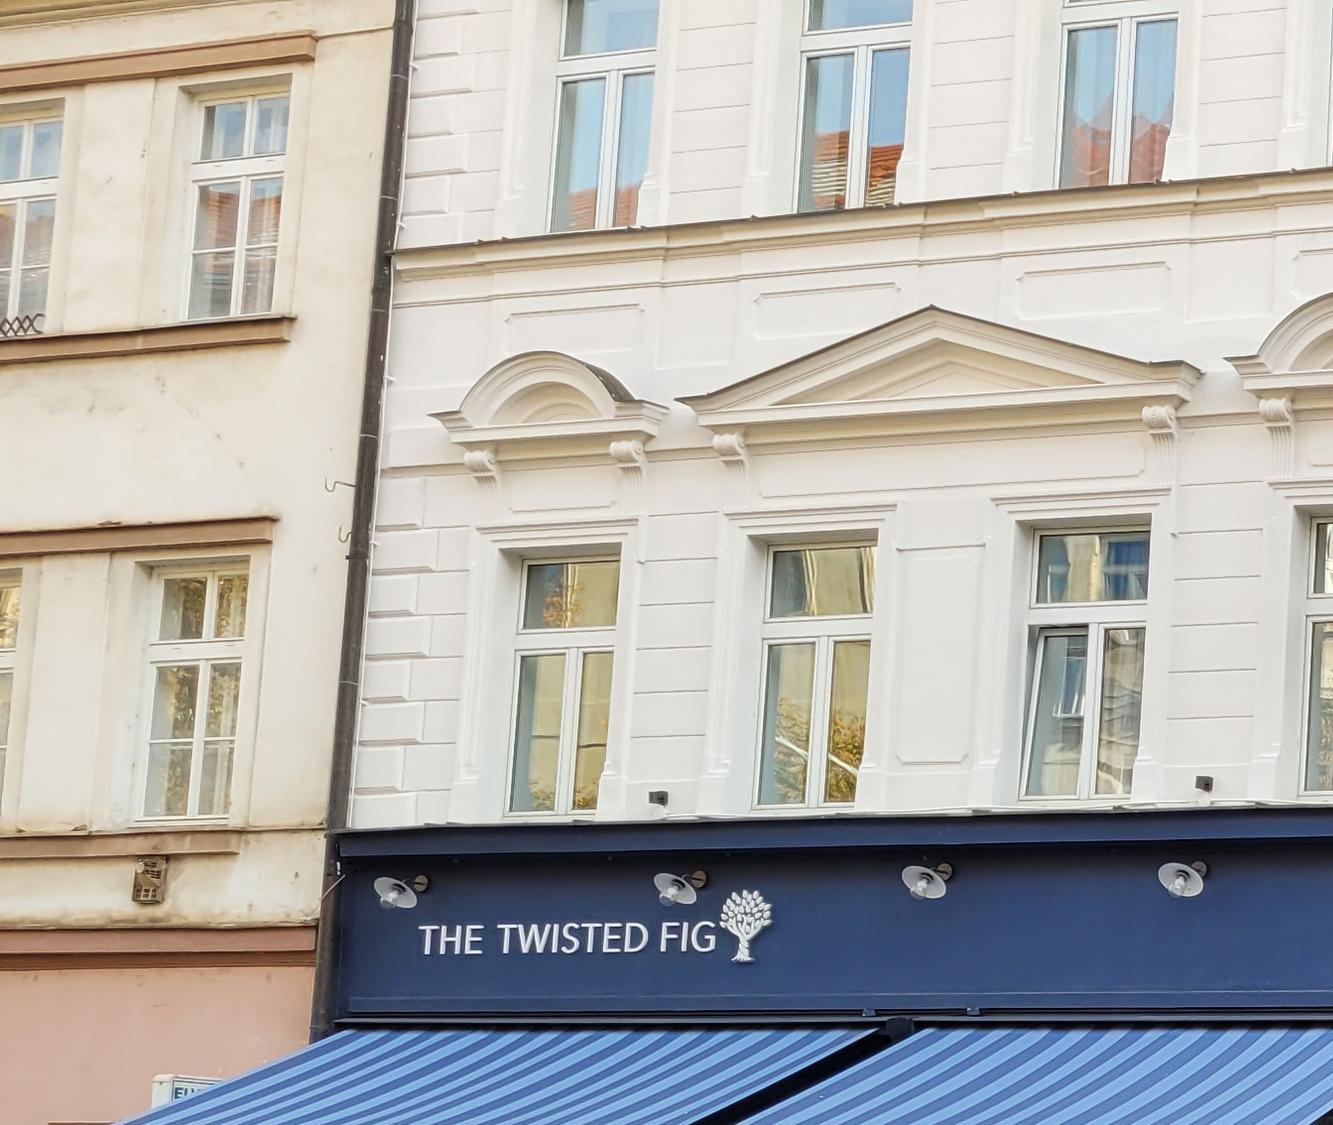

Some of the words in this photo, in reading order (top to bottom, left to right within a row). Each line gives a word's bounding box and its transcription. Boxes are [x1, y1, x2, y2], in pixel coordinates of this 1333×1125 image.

[418, 924, 485, 955] THE
[496, 922, 649, 954] TWISTED
[660, 920, 716, 952] FIG
